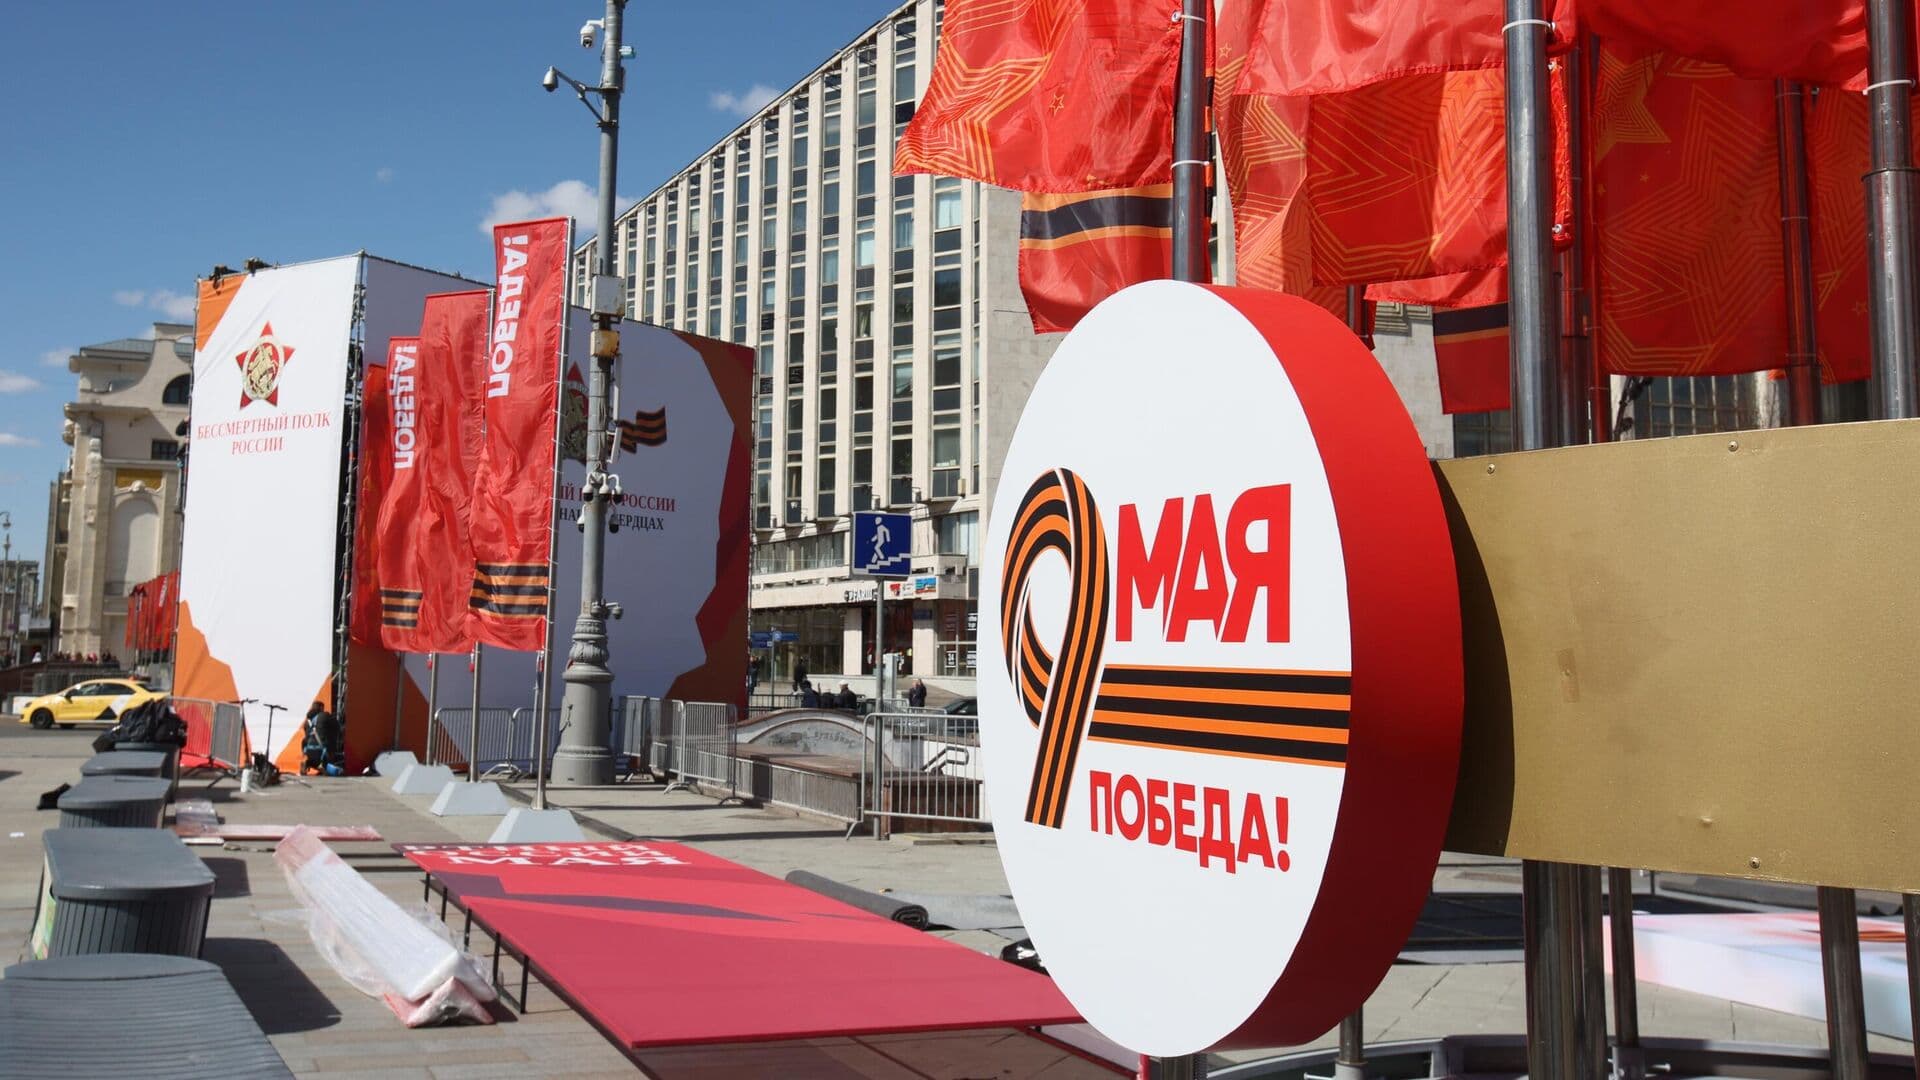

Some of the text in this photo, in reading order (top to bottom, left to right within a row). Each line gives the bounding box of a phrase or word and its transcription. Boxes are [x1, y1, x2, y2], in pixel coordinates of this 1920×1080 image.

[488, 234, 528, 398] ПОБЕДА!
[389, 345, 417, 469] ПОБЕДА!
[197, 411, 331, 440] БЕССМЕРТНЫЙ ПОЛК
[231, 437, 284, 455] РОССИИ
[621, 492, 675, 511] РОССИИ
[617, 514, 664, 531] ЕРДЦАХ
[1115, 483, 1291, 643] МАЯ
[1089, 770, 1291, 874] ПОБЕДА!
[448, 856, 692, 865] МАЯ
